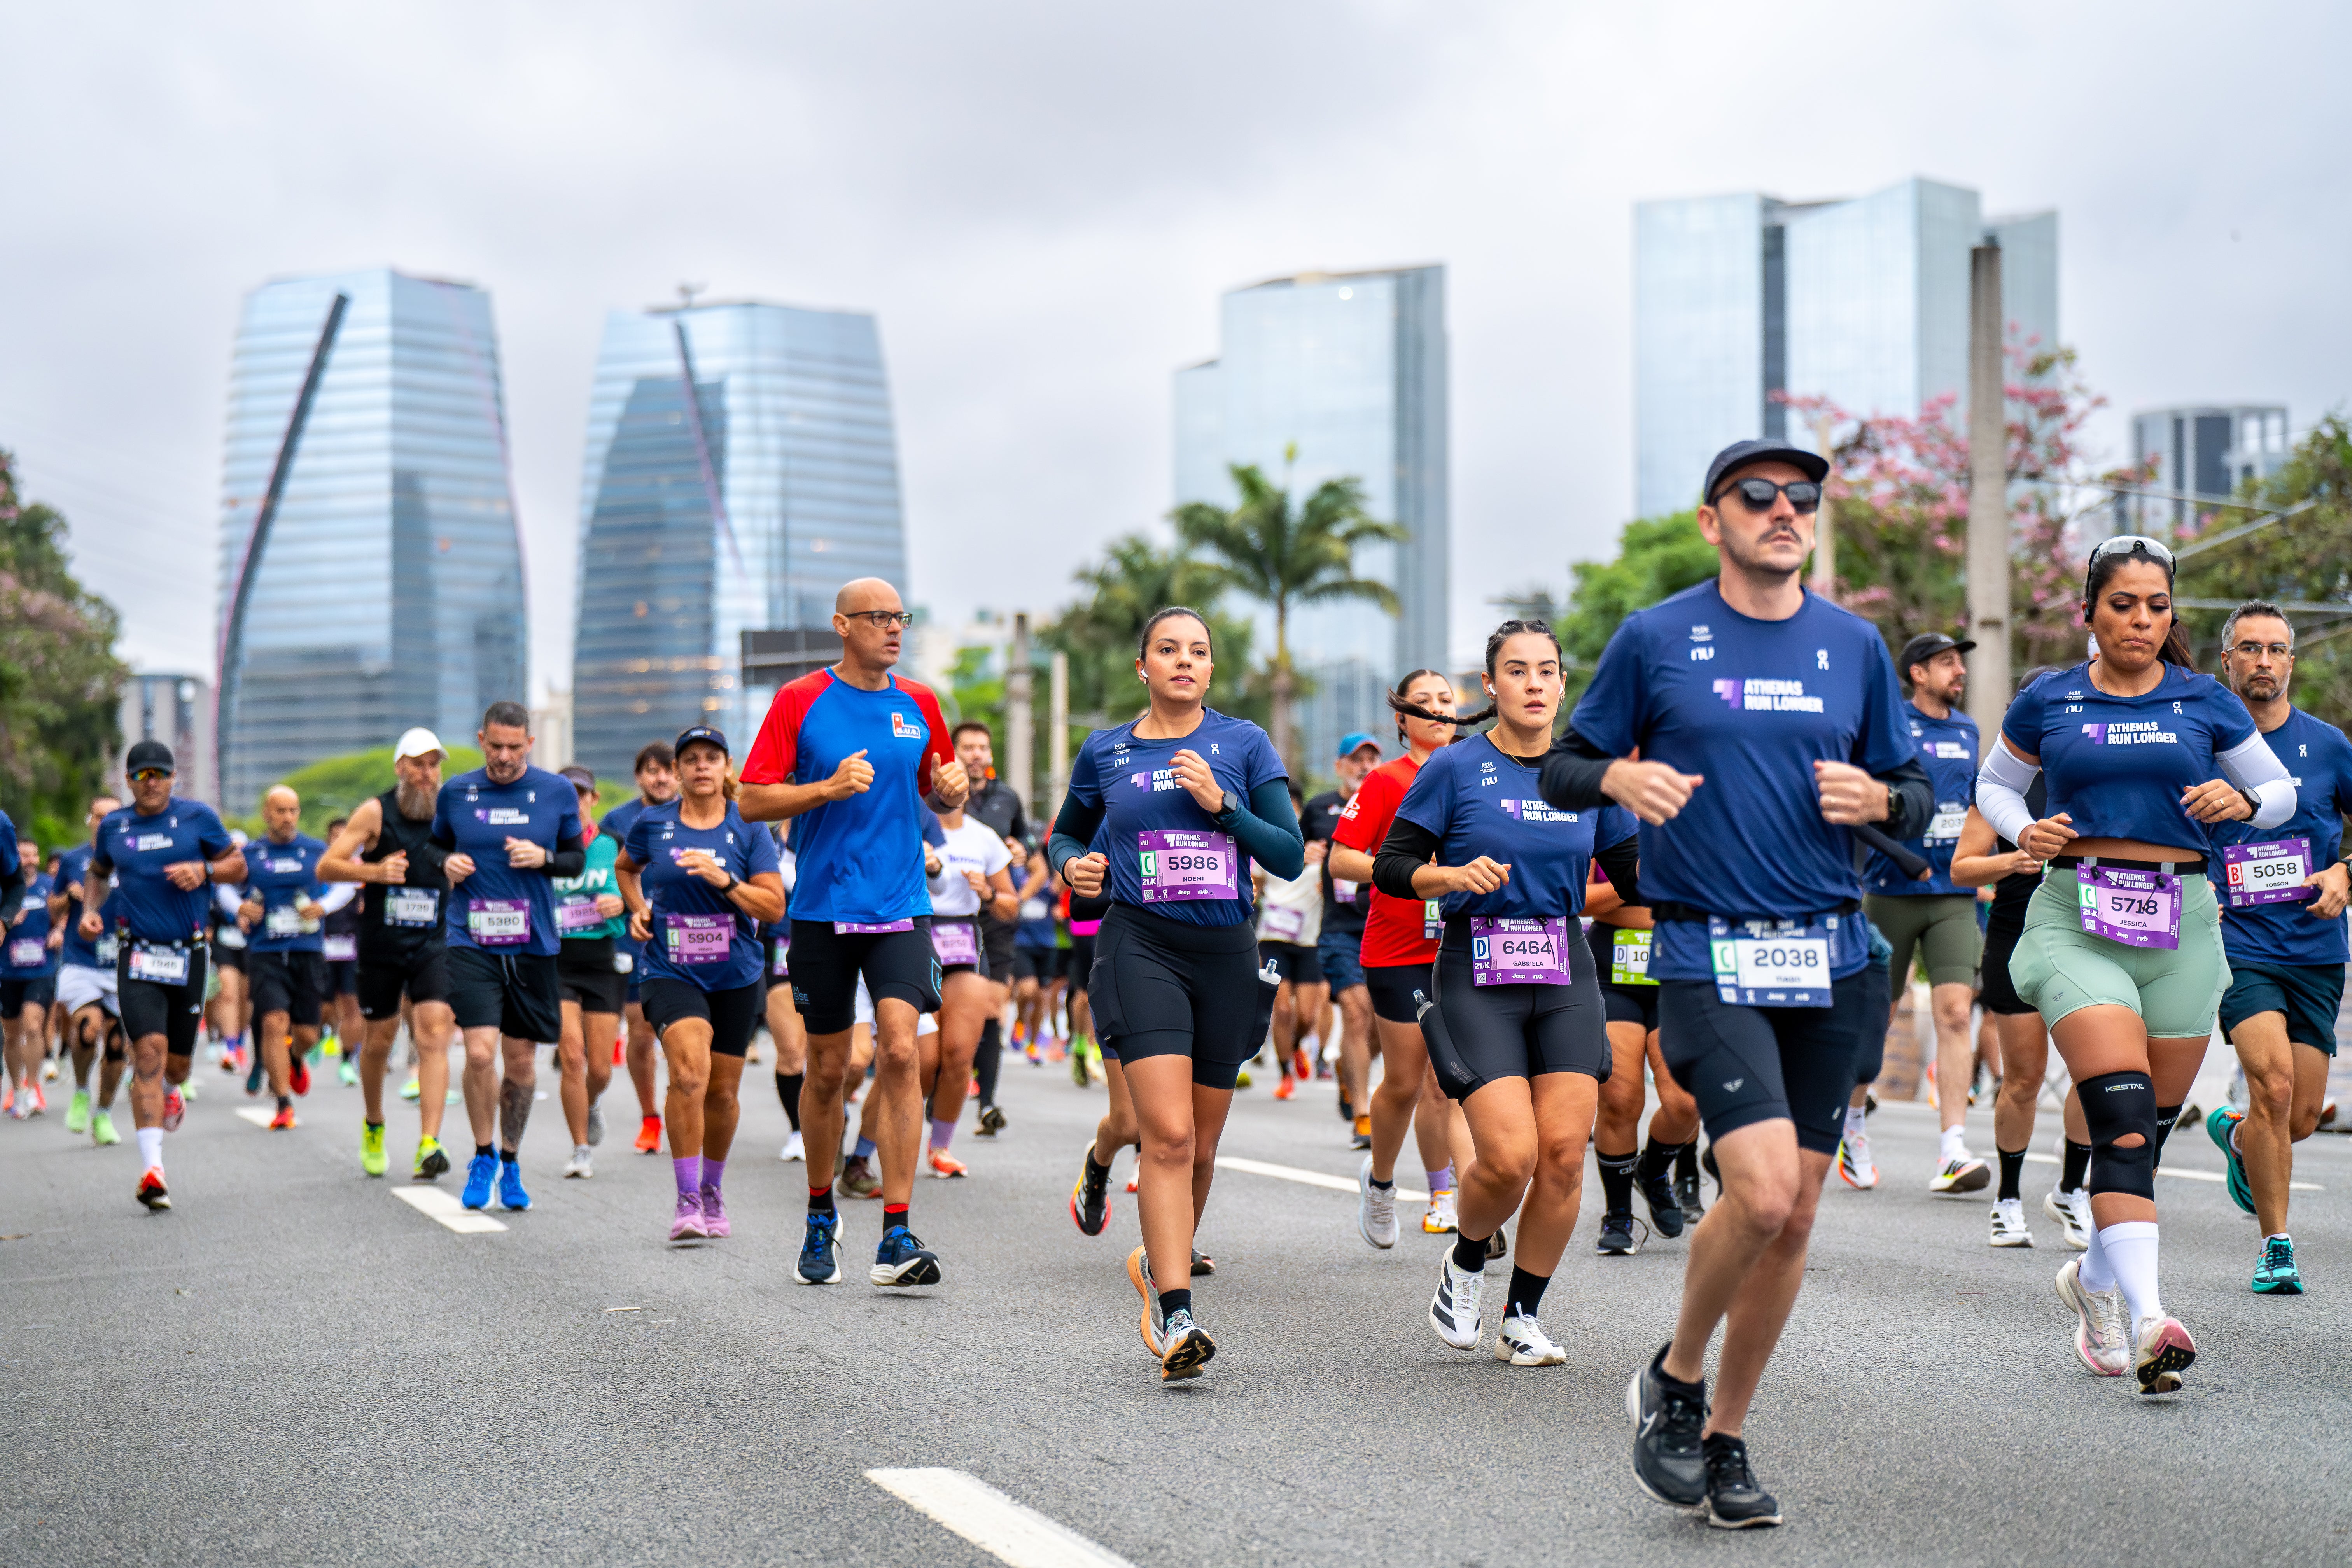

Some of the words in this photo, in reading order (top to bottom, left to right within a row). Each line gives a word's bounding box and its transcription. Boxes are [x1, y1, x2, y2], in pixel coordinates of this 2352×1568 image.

[1744, 679, 1803, 696] ATHENAS
[1744, 695, 1773, 711] RUN
[1773, 695, 1824, 713] LONGER
[2107, 721, 2158, 733] ATHENAS
[2108, 733, 2132, 745] RUN
[2134, 732, 2177, 744] LONGER
[1153, 780, 1174, 791] RUN
[1522, 810, 1542, 821] RUN
[1543, 811, 1578, 823] LONGER
[1144, 855, 1152, 873] C
[1169, 856, 1218, 871] 5986
[2253, 863, 2297, 878] 5058
[2119, 873, 2146, 882] ATHENAS
[2231, 867, 2239, 882] B
[2131, 882, 2154, 890] LONGER
[2085, 888, 2093, 905] C
[2111, 896, 2158, 915] 5718
[688, 933, 722, 943] 5904
[1477, 940, 1486, 957] D
[1503, 941, 1551, 955] 6464
[1618, 948, 1624, 961] D
[1755, 948, 1818, 968] 2038
